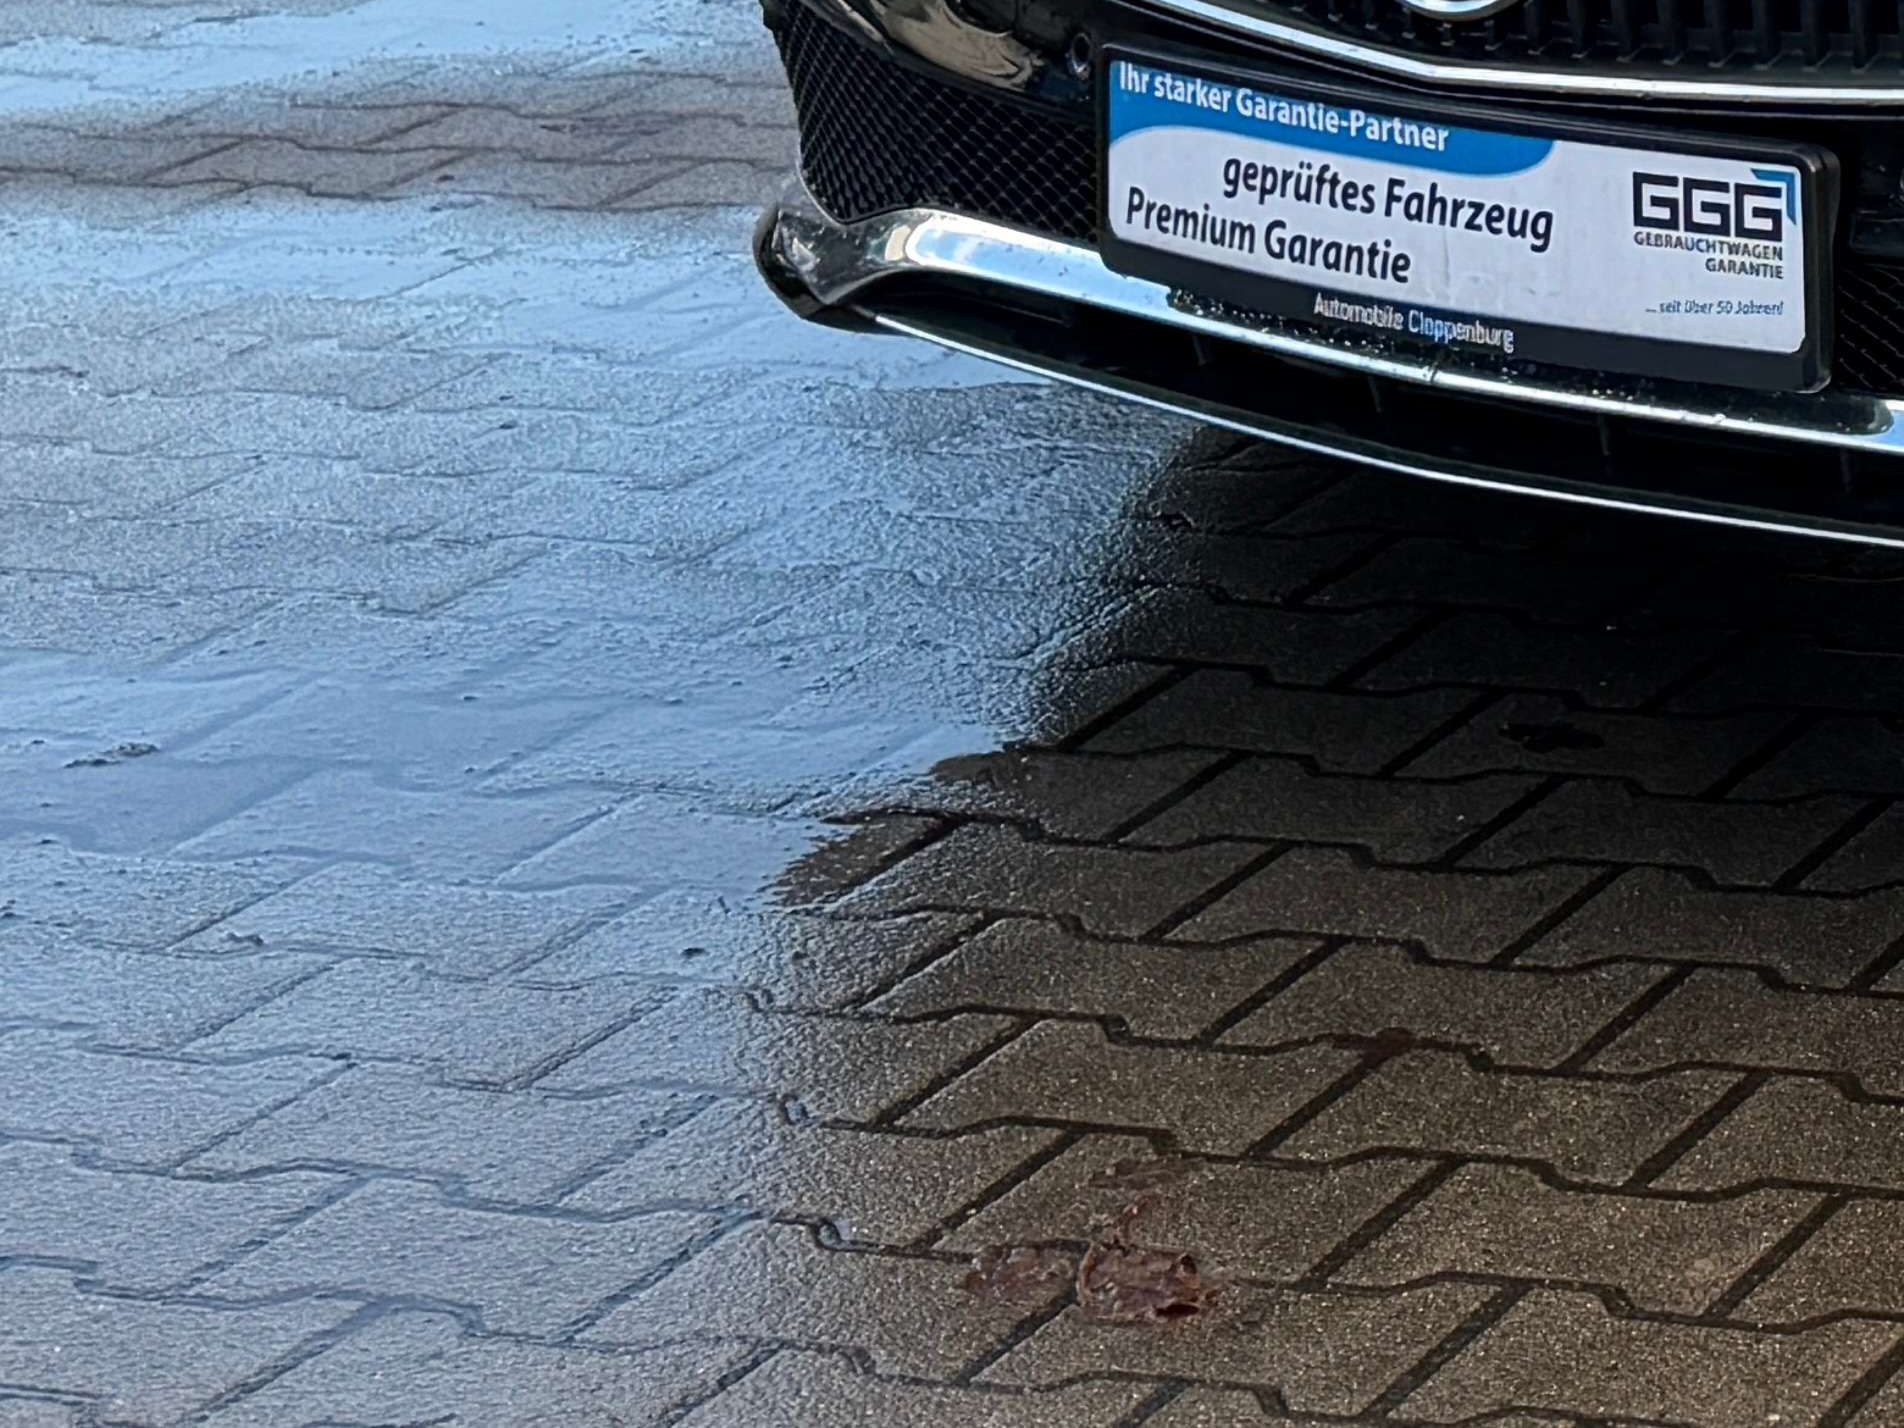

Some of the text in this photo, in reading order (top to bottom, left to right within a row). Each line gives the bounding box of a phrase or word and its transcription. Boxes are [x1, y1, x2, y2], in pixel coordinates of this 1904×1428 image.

[1119, 60, 1449, 152] Ihr starker Garantie-Partner
[1126, 186, 1411, 283] Premium Garantie
[1223, 157, 1554, 253] geprüftes Fahrzeug
[1632, 171, 1783, 243] GGG
[1633, 231, 1784, 262] GEBRAUCHTWAGEN
[1704, 258, 1784, 280] GARANTIE
[1314, 292, 1515, 354] Automobile Cloppenburg
